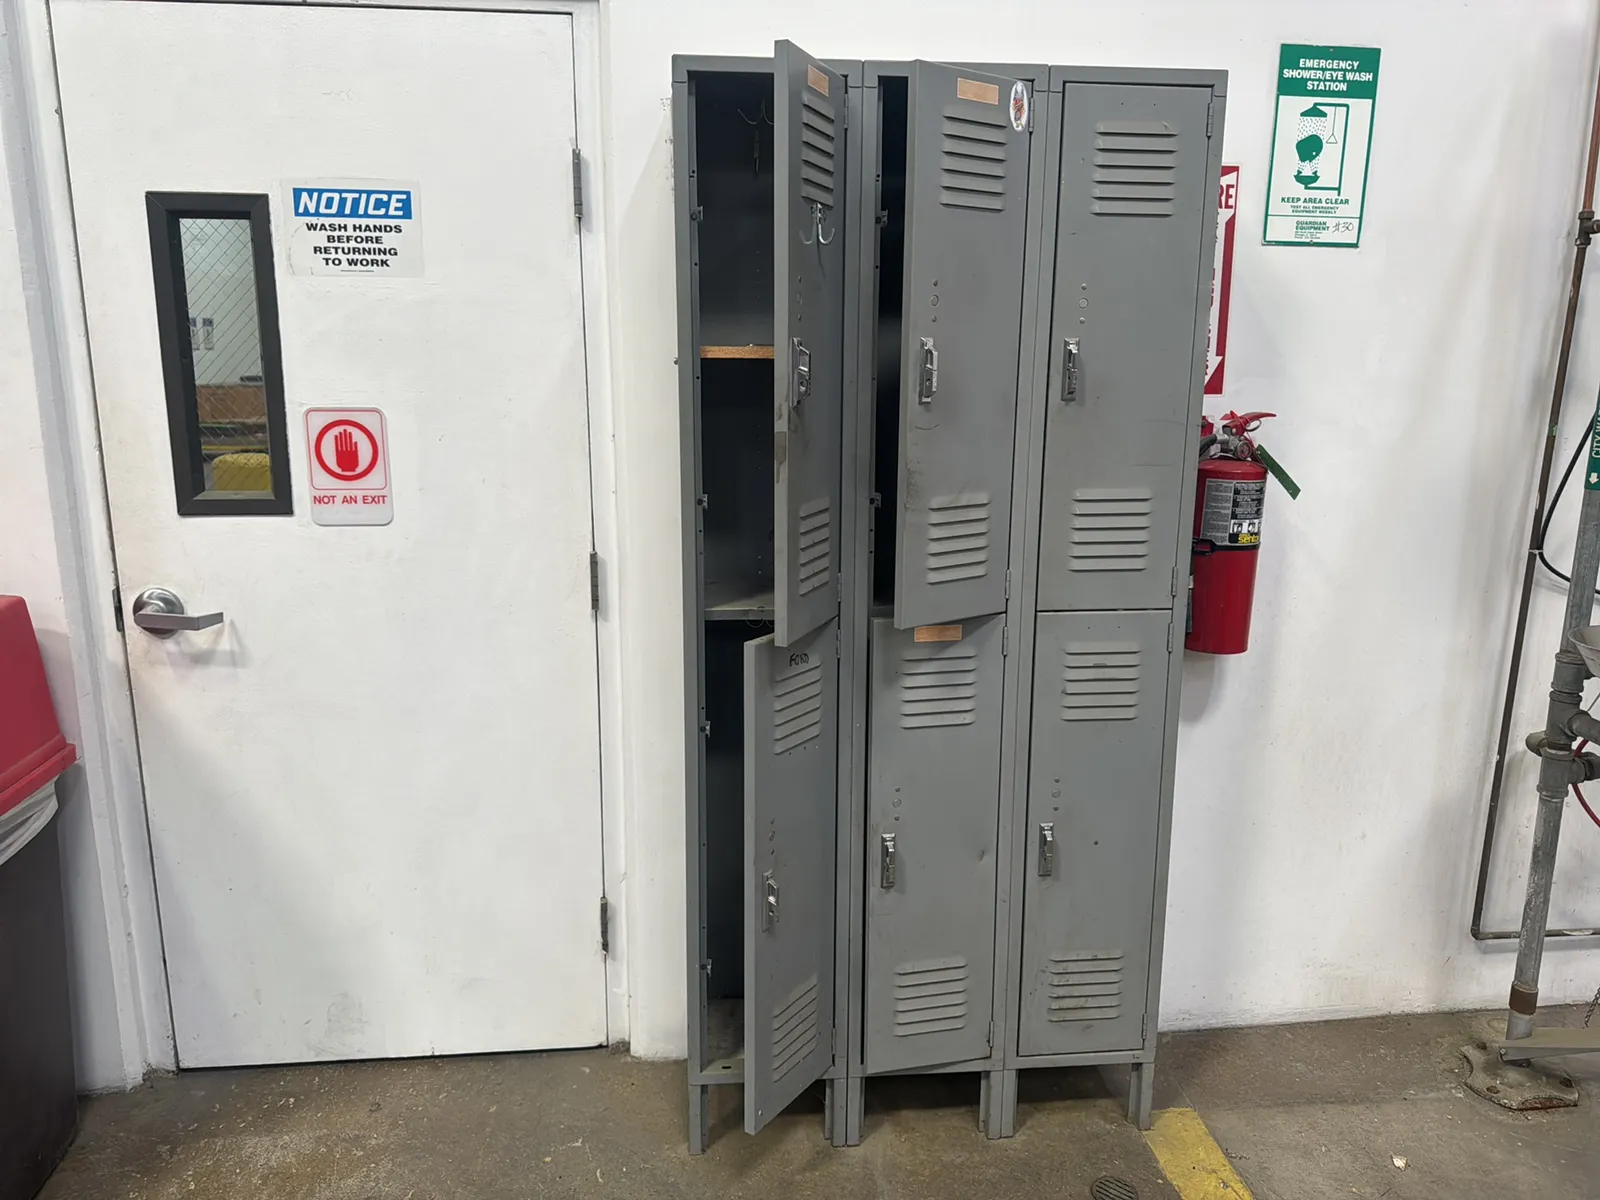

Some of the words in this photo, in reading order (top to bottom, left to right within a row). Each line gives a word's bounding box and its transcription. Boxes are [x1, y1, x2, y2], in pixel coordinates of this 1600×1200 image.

[1299, 58, 1359, 70] EMERGENCY
[1283, 69, 1344, 80] SHOWER/EYE
[1345, 72, 1373, 81] WASH
[1306, 81, 1347, 91] STATION
[298, 191, 407, 216] NOTICE
[1302, 197, 1323, 205] AREA
[306, 222, 348, 232] WASH
[352, 224, 402, 234] HANDS
[1332, 221, 1354, 234] #30
[326, 234, 384, 245] BEFORE
[313, 246, 398, 257] RETURNING
[322, 257, 342, 267] TO
[346, 258, 391, 268] WORK
[313, 495, 337, 505] NOT
[341, 495, 358, 505] AN
[362, 495, 388, 505] EXIT
